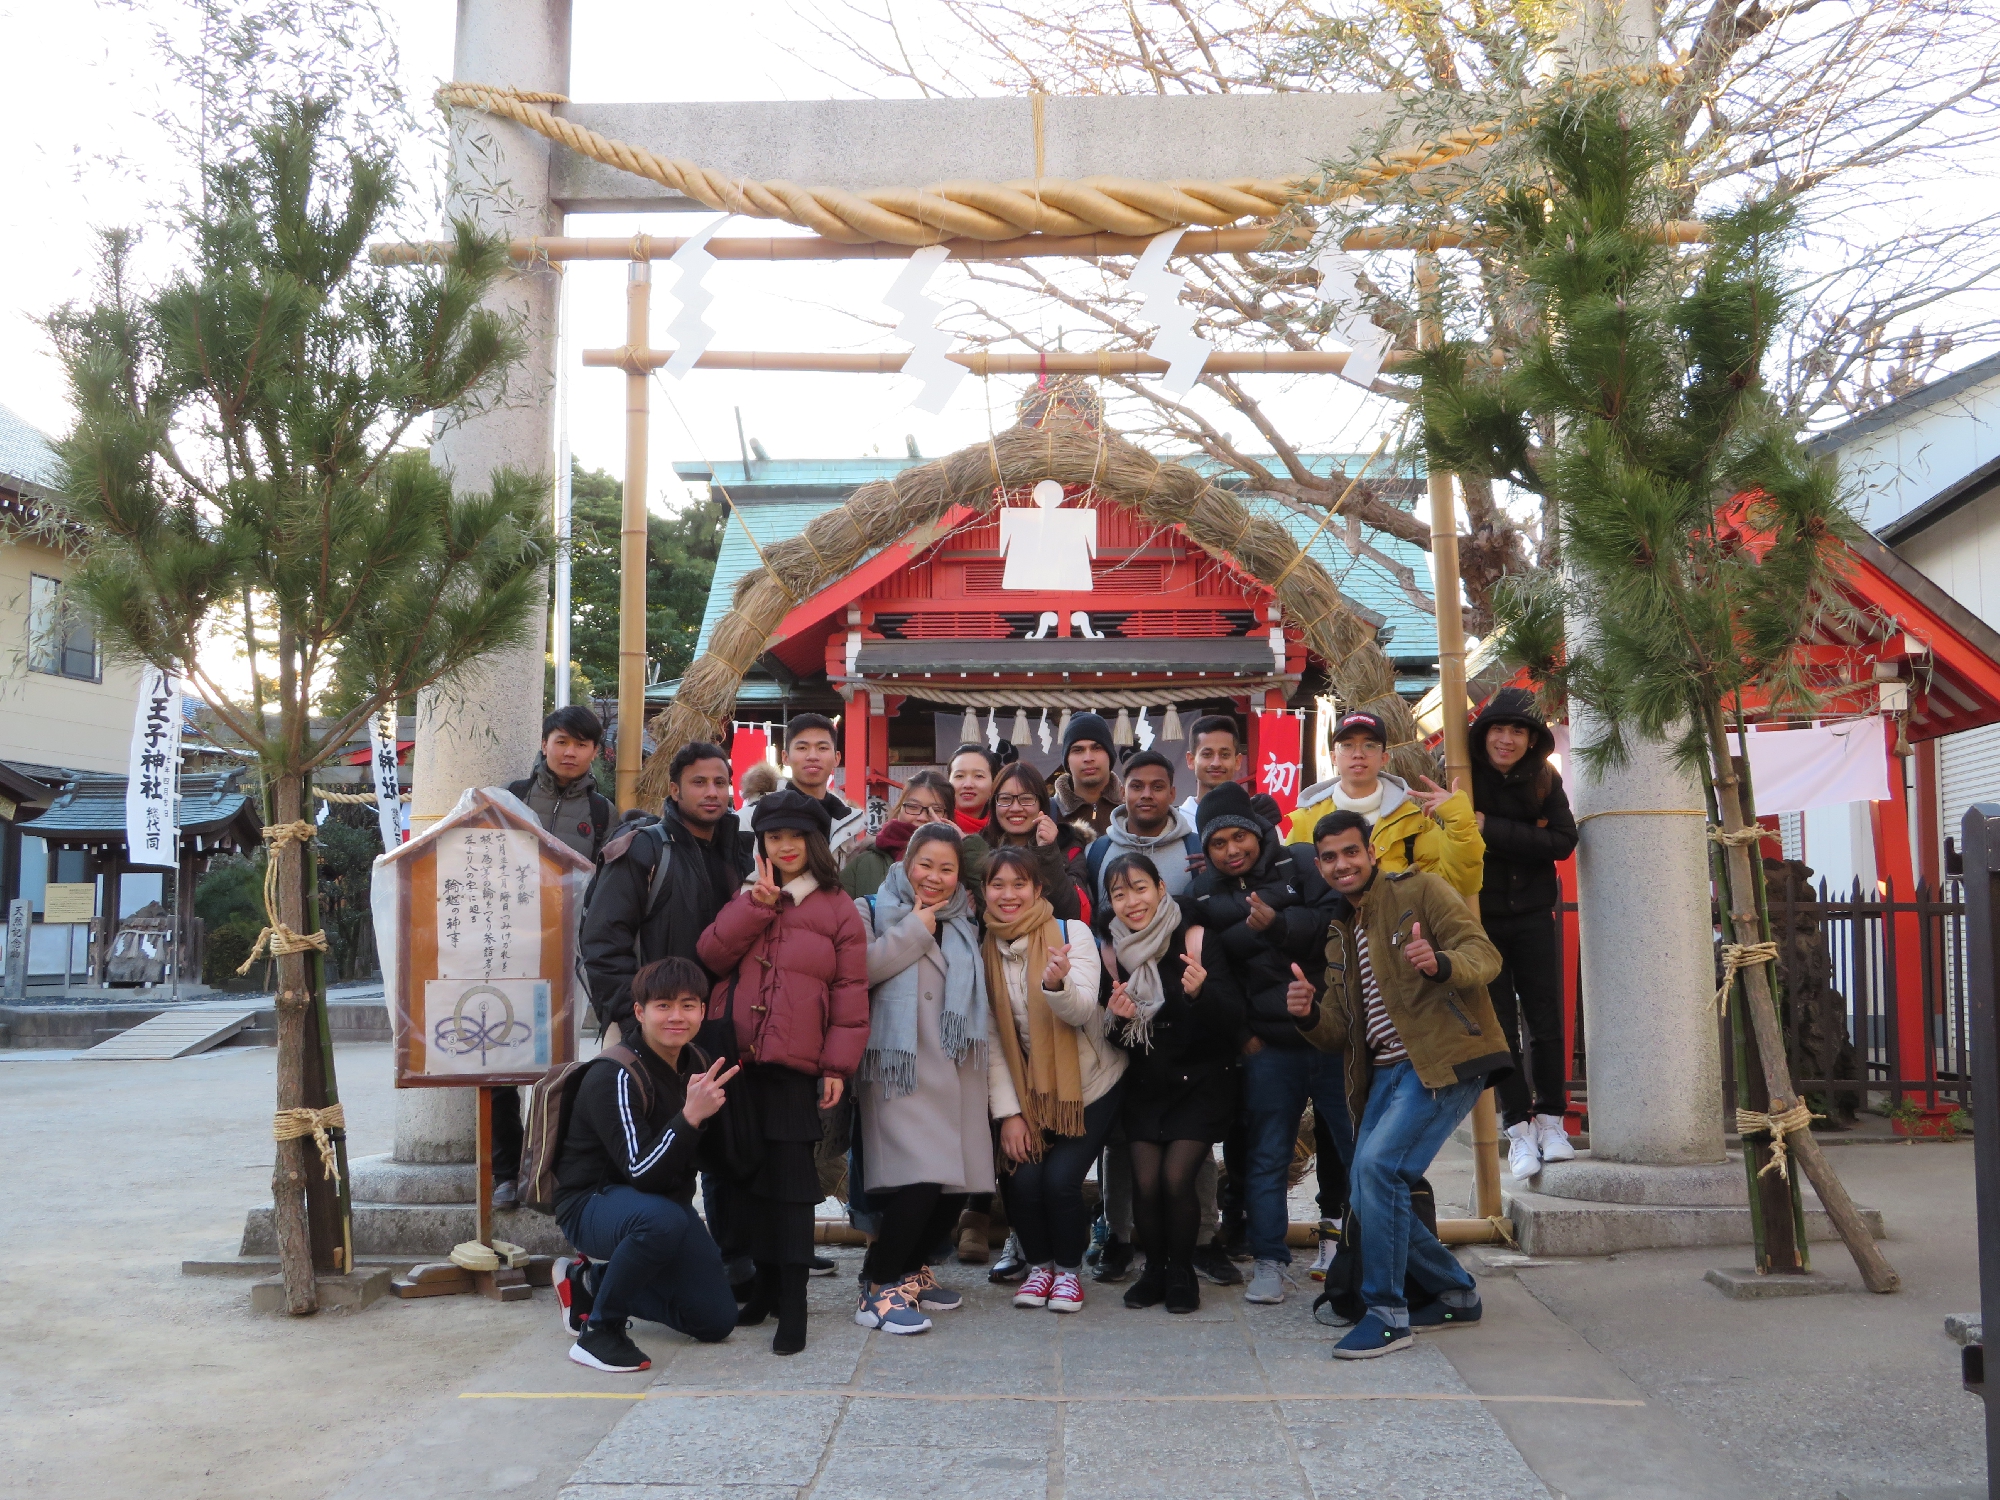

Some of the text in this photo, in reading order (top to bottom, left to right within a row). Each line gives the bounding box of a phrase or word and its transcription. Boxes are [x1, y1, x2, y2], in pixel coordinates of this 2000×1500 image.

[140, 669, 173, 799] 八王子神社
[1263, 751, 1297, 796] 初
